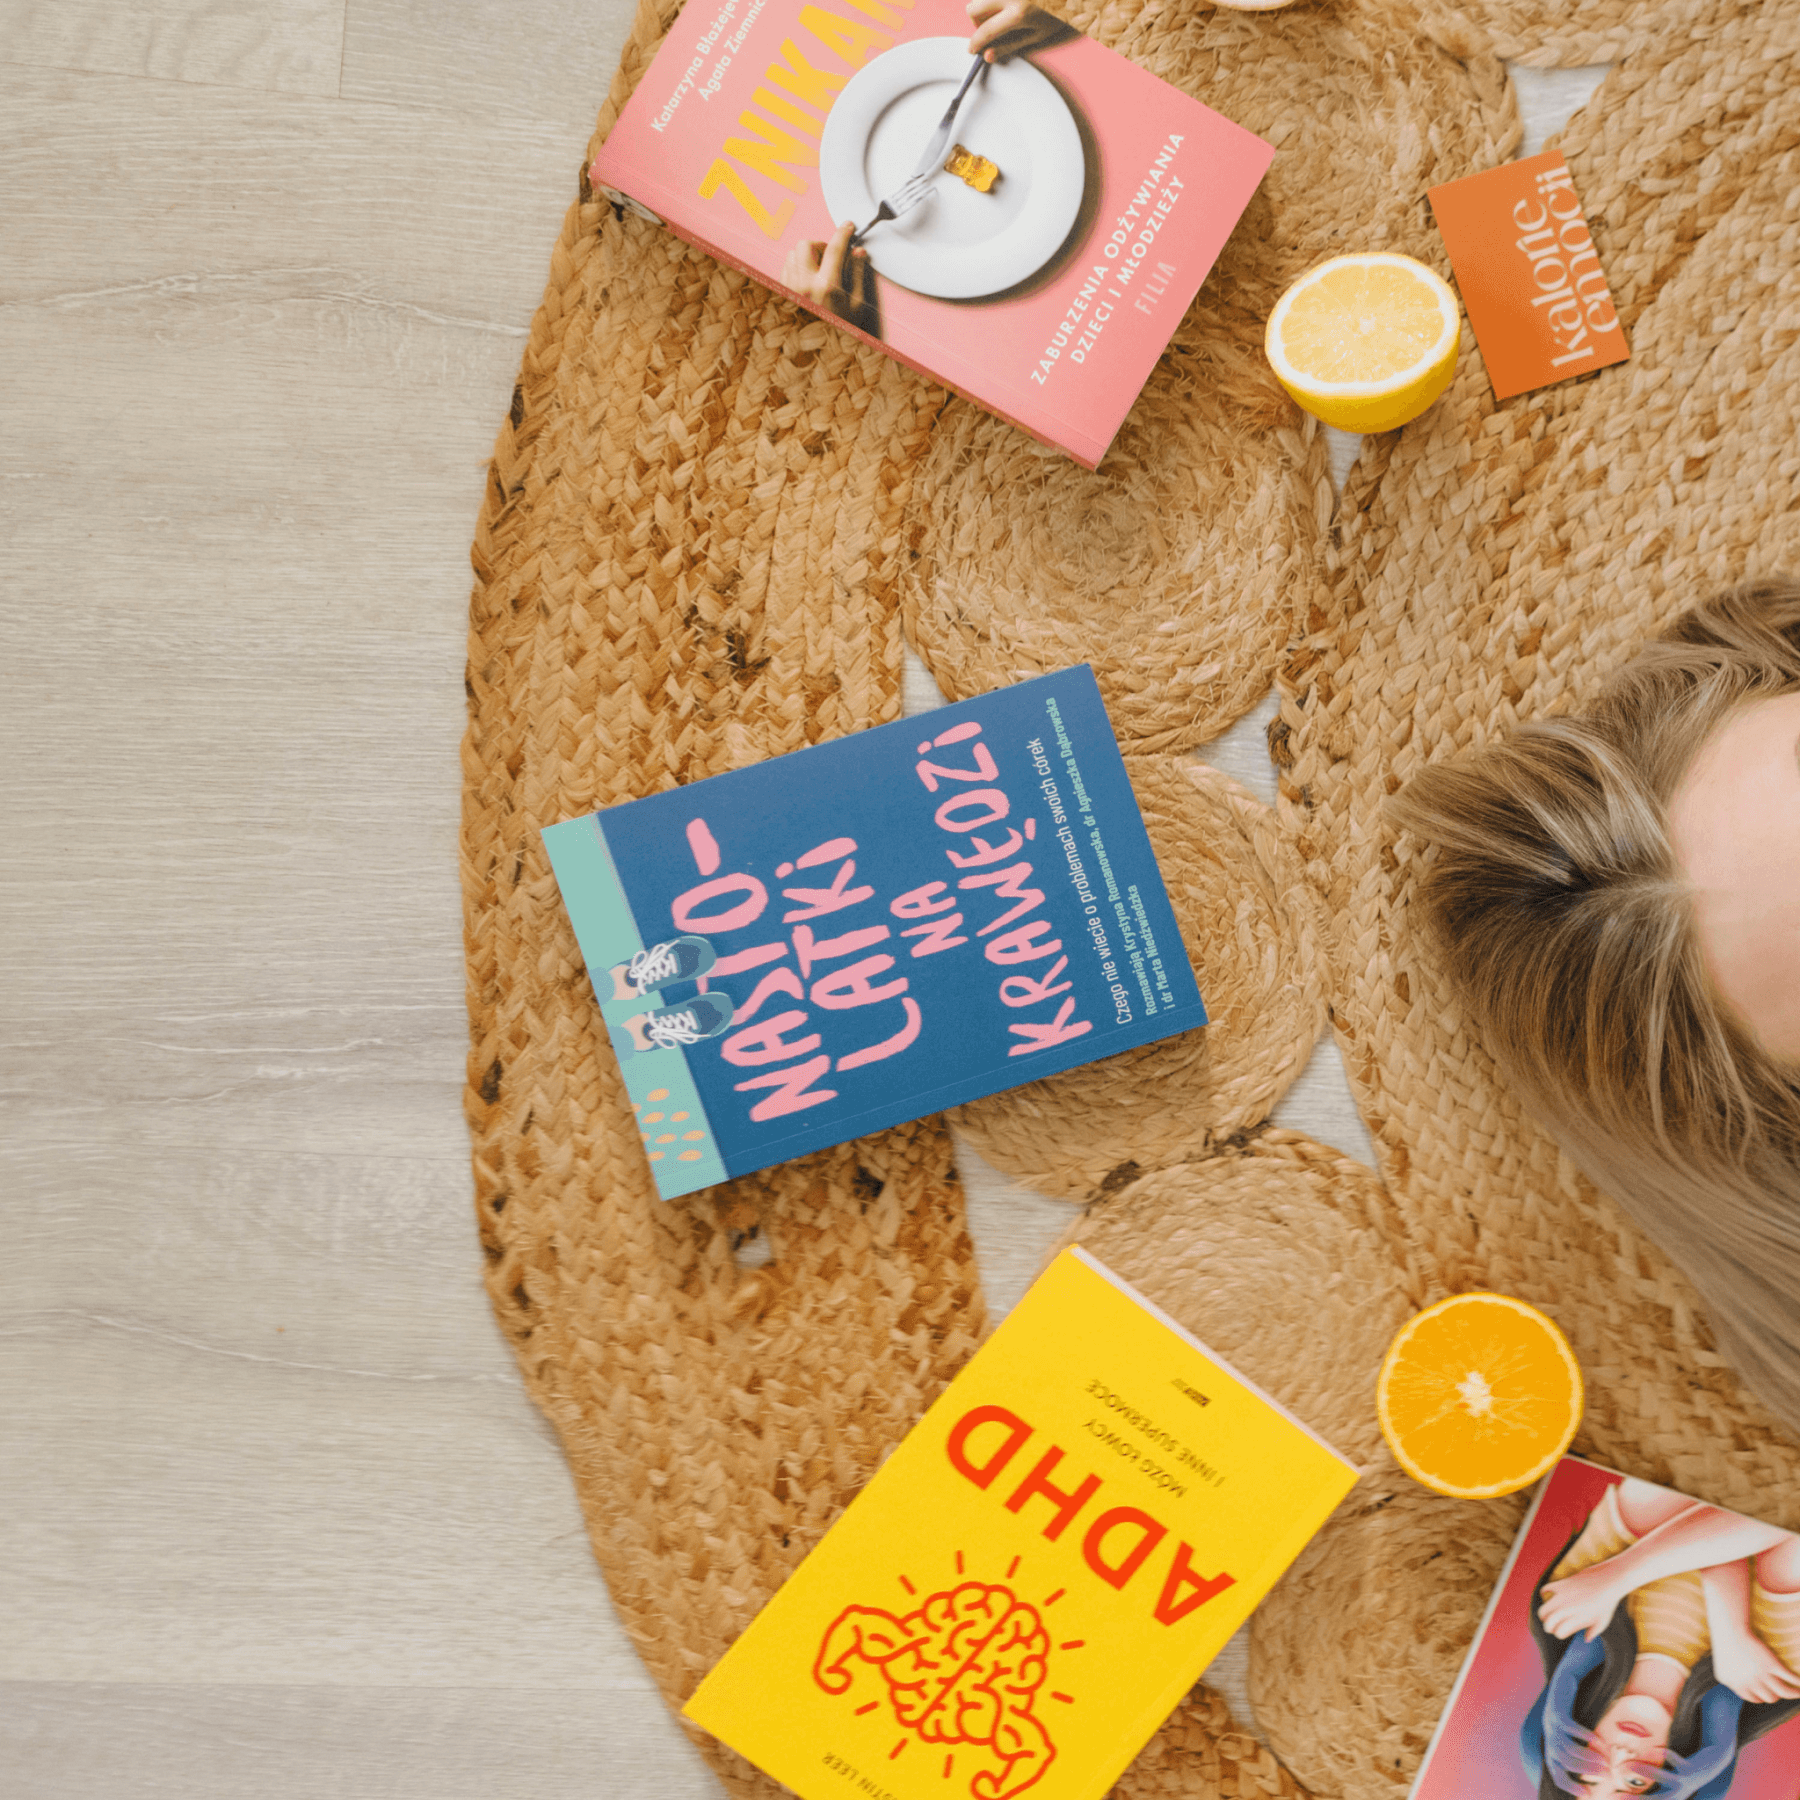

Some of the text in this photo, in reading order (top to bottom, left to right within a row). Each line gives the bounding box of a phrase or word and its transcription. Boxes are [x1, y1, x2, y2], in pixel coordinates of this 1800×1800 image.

[650, 56, 704, 132] Katarzyna
[697, 54, 732, 101] Agata
[1031, 134, 1185, 386] ZABURZENIA ODŻYWIANIA
[1071, 175, 1184, 364] DZIECI I MŁODZIEŻY
[1134, 261, 1177, 315] FILIA
[1026, 737, 1133, 1025] Czego nie wiecie o problemach swoich córek
[1045, 697, 1158, 1016] Rozmawiają Krystyna Romanowska, dr Agnieszka Dąbrowska
[890, 881, 969, 958] NA
[1127, 884, 1177, 1010] i dr Marta Niedźwiedzka
[1085, 1378, 1177, 1452] SUPERMOCE
[1083, 1420, 1188, 1497] MÓZG ŁOWCY
[1175, 1447, 1217, 1482] INNE
[946, 1404, 1237, 1627] ADHD
